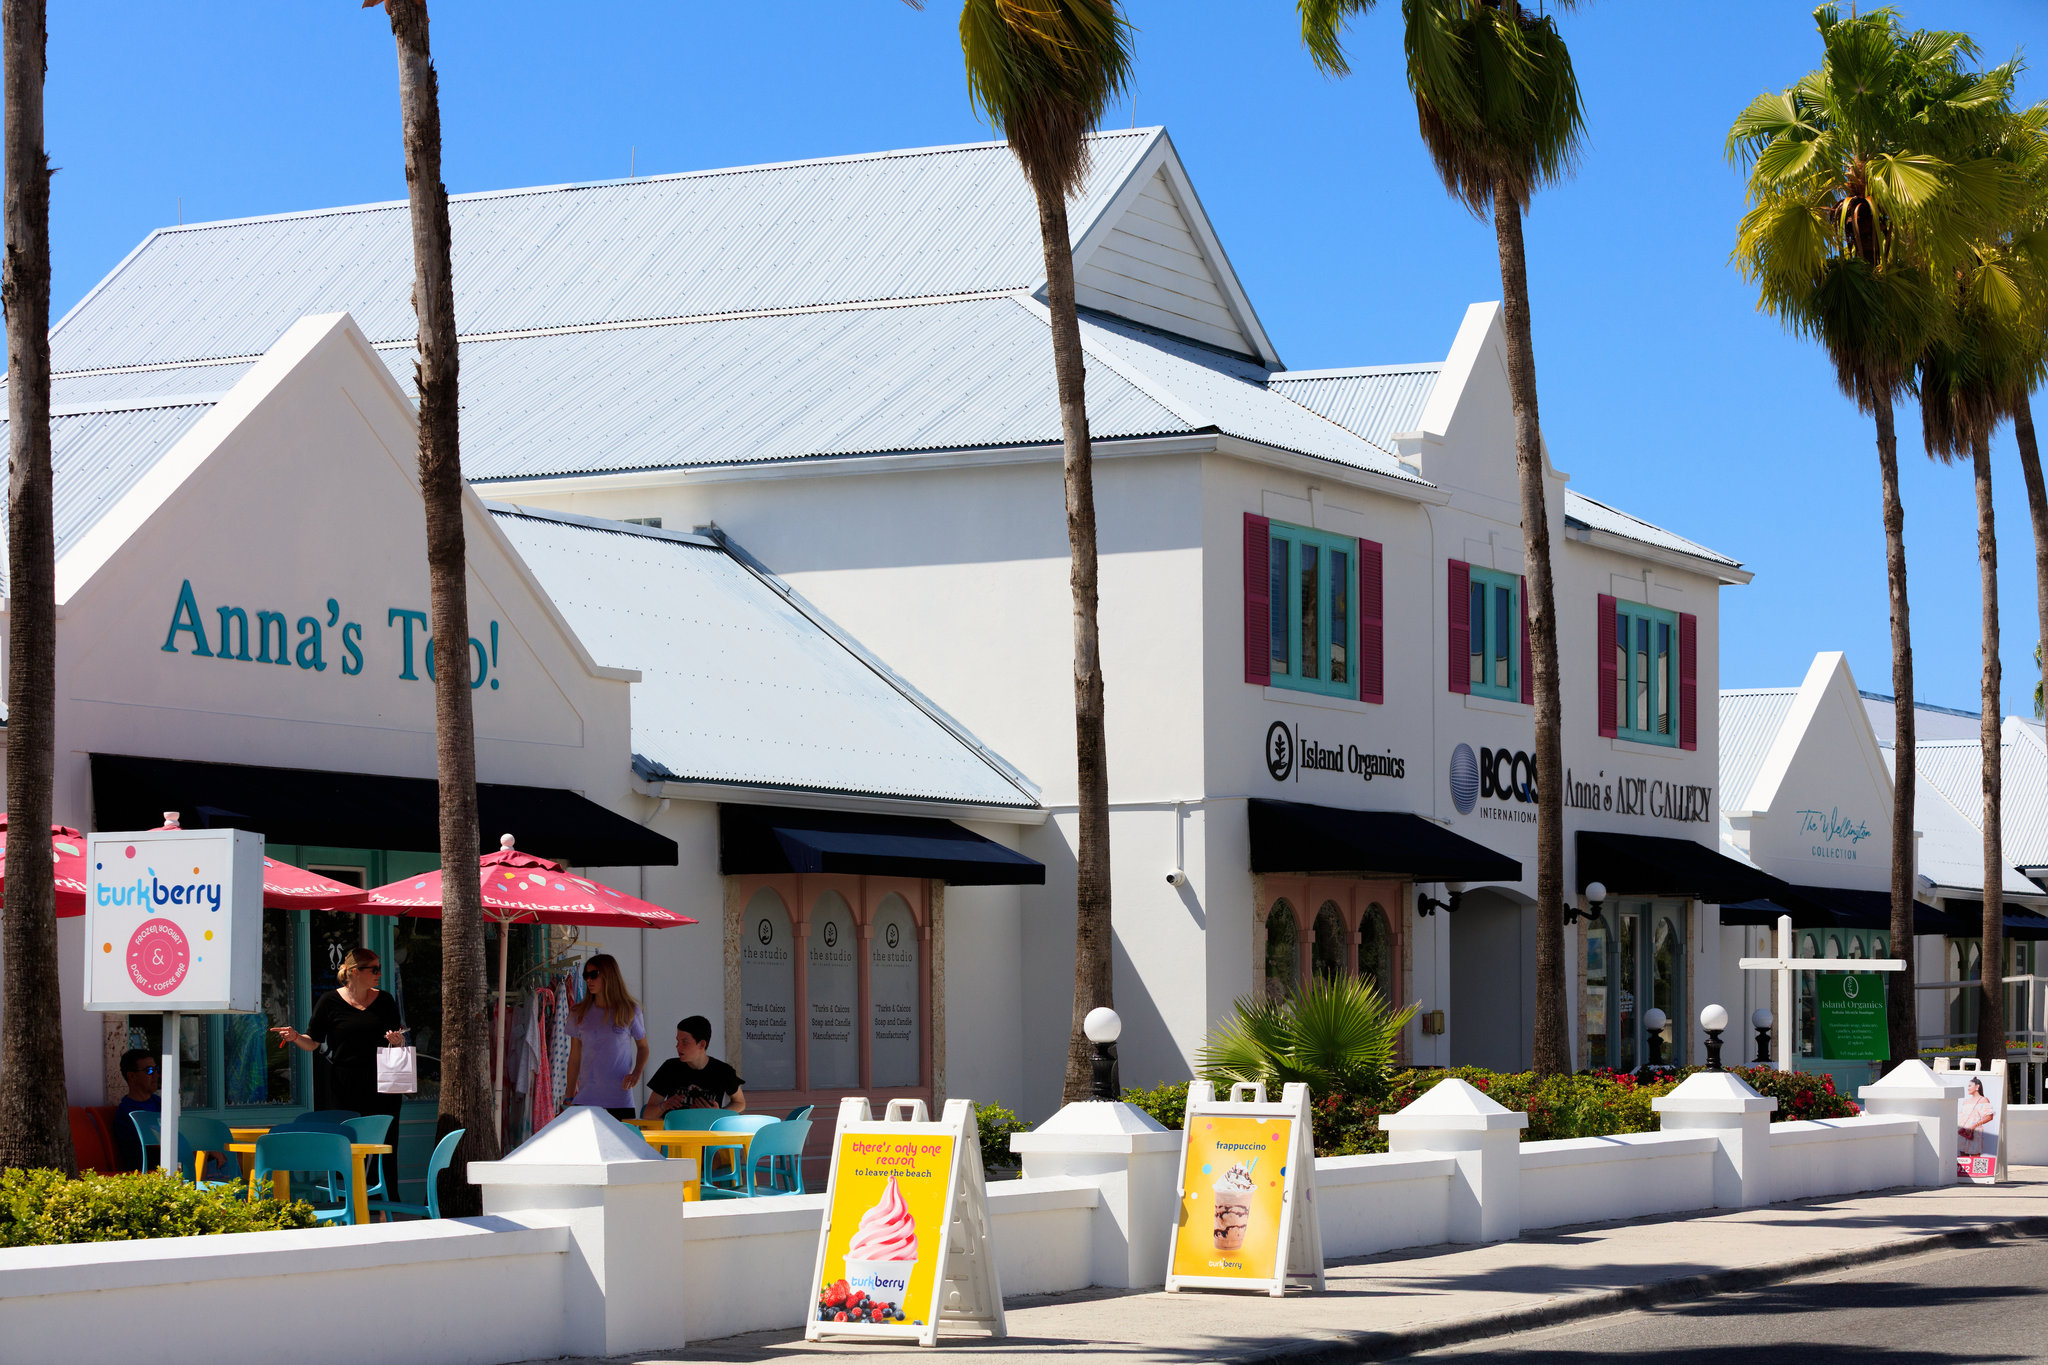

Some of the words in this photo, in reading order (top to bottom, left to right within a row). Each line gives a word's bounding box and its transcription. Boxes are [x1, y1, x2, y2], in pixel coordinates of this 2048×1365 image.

[161, 579, 364, 676] Anna's
[1300, 739, 1344, 772] Island
[1348, 744, 1405, 781] Organics
[1564, 768, 1612, 811] Anna's
[1616, 776, 1647, 816] ART
[1650, 780, 1712, 823] GALLERY
[1480, 807, 1538, 824] INTERNATIONA
[1796, 809, 1822, 835] The
[1820, 806, 1872, 844] Wellington
[1811, 846, 1857, 860] COLLECTION
[97, 873, 221, 914] turkberry
[483, 895, 596, 913] turkberry
[135, 925, 159, 945] FROZEN
[158, 925, 183, 945] YOGURT
[152, 948, 165, 966] &
[743, 947, 759, 959] the
[759, 948, 788, 961] studio
[809, 949, 825, 961] the
[825, 950, 852, 962] studio
[872, 951, 887, 962] the
[887, 953, 913, 963] studio
[130, 963, 148, 986] DONUT
[153, 976, 177, 990] COFFEE
[174, 962, 186, 978] BAR
[1821, 1000, 1846, 1009] Island
[1847, 1000, 1883, 1010] Organics
[745, 1017, 758, 1029] Soap
[759, 1018, 769, 1027] and
[769, 1018, 787, 1027] Candle
[811, 1018, 824, 1030] Soap
[825, 1018, 834, 1027] and
[834, 1018, 851, 1027] Candle
[874, 1018, 886, 1029] Soap
[887, 1018, 896, 1027] and
[896, 1018, 912, 1027] Candle
[852, 1141, 891, 1156] there's
[894, 1143, 917, 1156] only
[920, 1145, 942, 1156] one
[1216, 1141, 1266, 1152] frappuccino
[876, 1156, 915, 1169] reason
[854, 1168, 864, 1177] to
[865, 1168, 889, 1177] leave
[890, 1168, 904, 1178] the
[905, 1169, 932, 1178] beach
[1208, 1258, 1242, 1270] turkberry
[851, 1273, 905, 1292] turkberry
